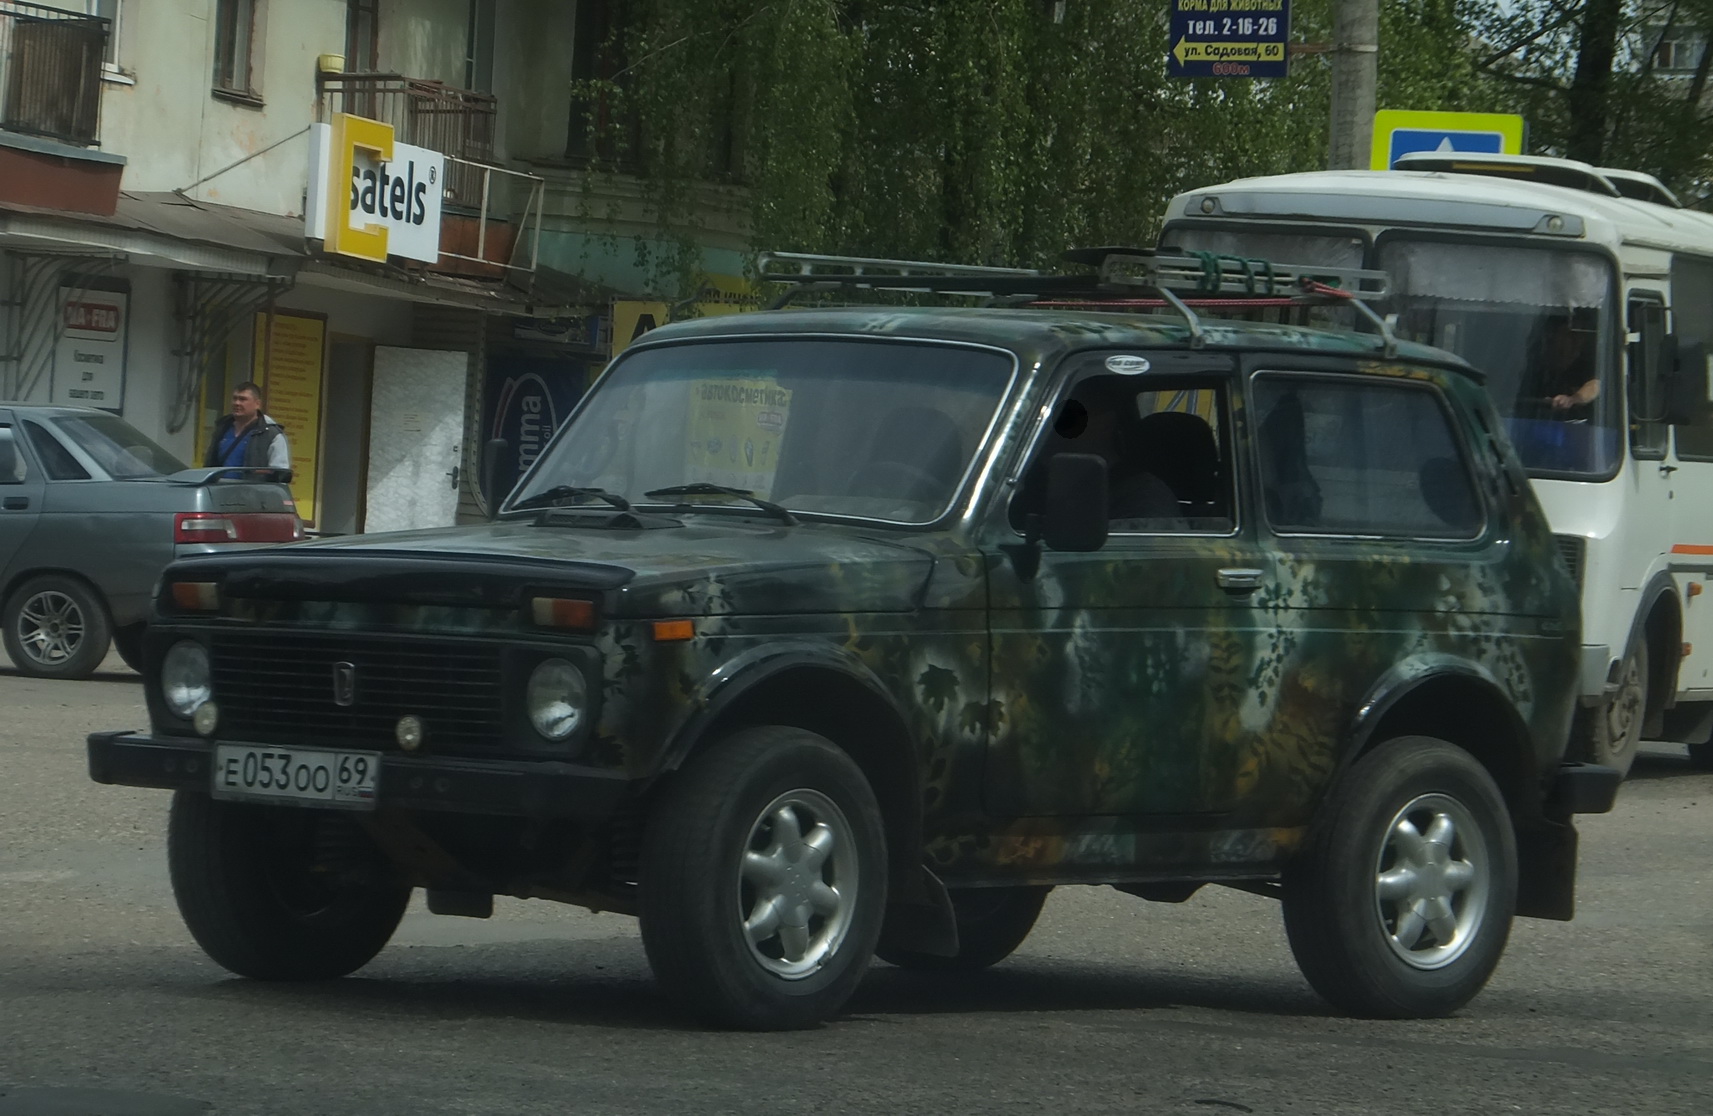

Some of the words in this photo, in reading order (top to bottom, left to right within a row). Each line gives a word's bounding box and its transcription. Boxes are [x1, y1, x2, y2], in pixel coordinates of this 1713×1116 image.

[1188, 20, 1218, 35] тел.
[1222, 17, 1278, 35] 2-16-26
[1184, 46, 1201, 58] ул.
[1264, 45, 1280, 56] 60
[1212, 61, 1250, 75] 600м
